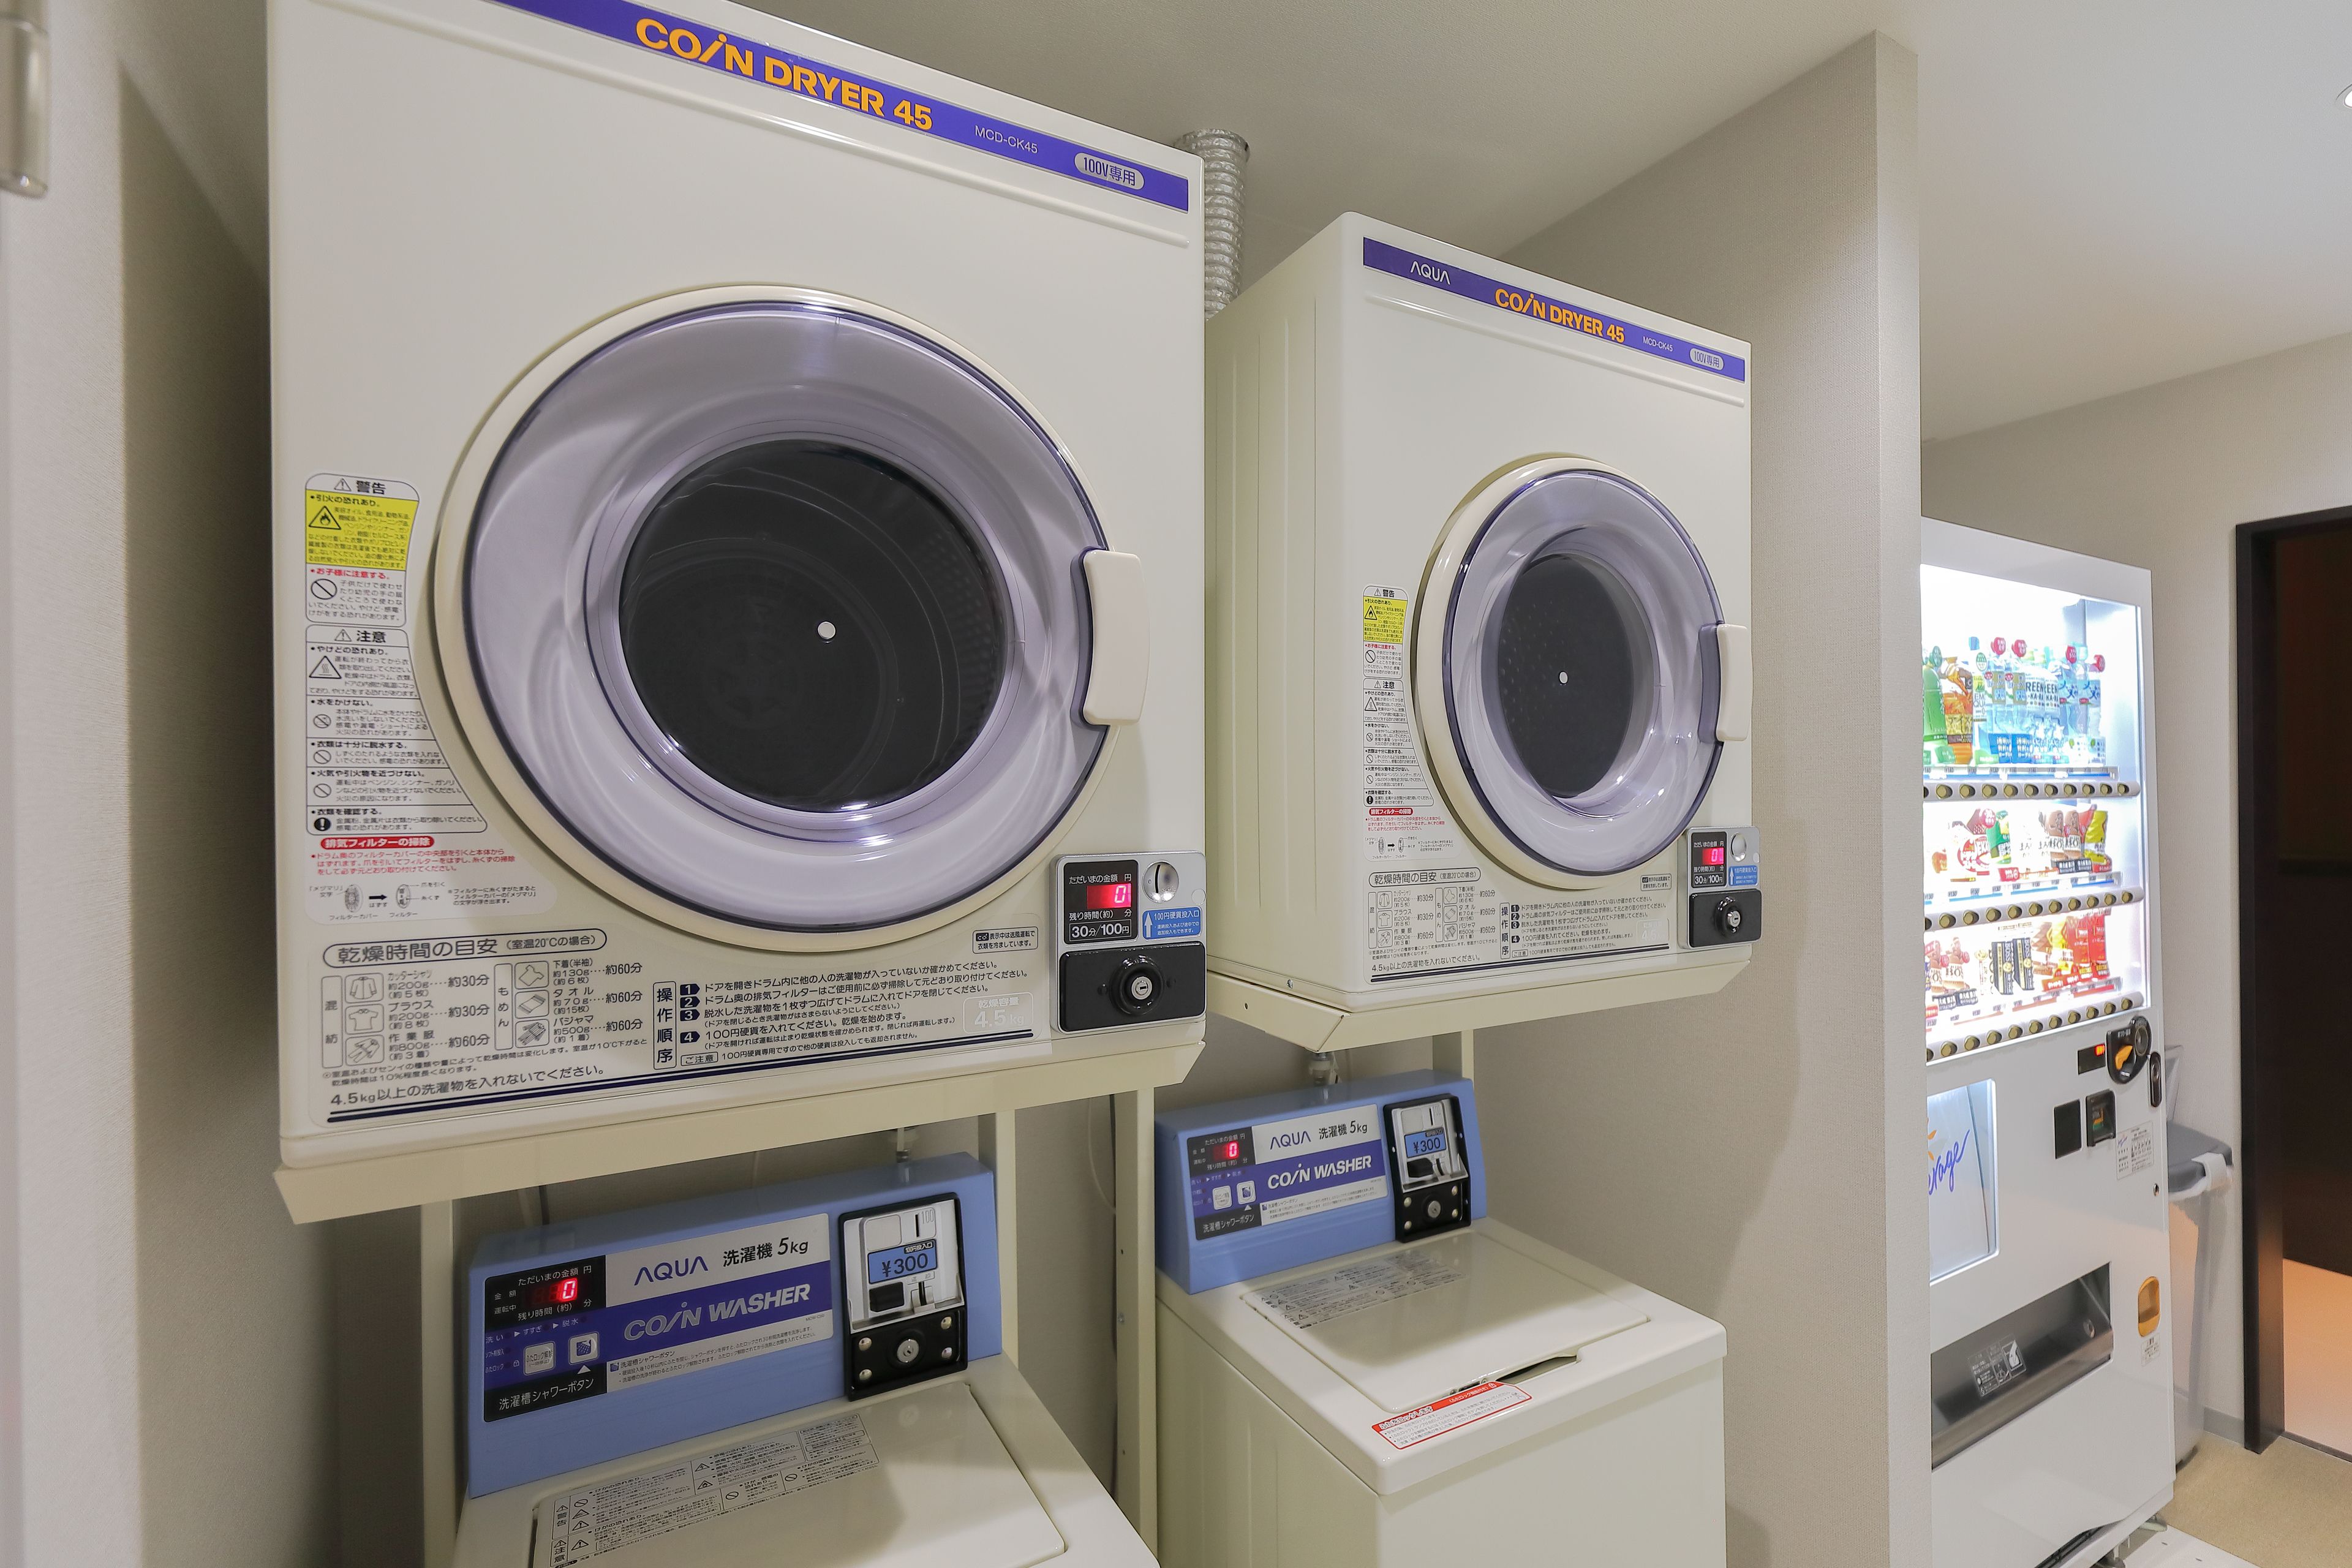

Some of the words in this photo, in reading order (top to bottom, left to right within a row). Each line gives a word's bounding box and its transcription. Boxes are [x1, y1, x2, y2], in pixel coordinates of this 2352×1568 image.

[764, 55, 884, 117] DRYER
[893, 99, 933, 130] 45
[974, 125, 1038, 154] MCD-CK45
[1083, 157, 1136, 186] 100V専用
[1411, 261, 1450, 285] AQUA
[1550, 305, 1603, 336] DRYER
[1607, 324, 1624, 343] 45
[1643, 336, 1673, 352] MCD-CK45
[1694, 351, 1719, 368] 100V専用
[356, 480, 386, 494] 警告
[1382, 589, 1395, 598] 警告
[356, 631, 386, 643] 注意
[325, 837, 431, 848] 排気フィルターの掃除
[1069, 874, 1118, 884] ただいまの金額
[1374, 872, 1437, 885] 乾燥時間の目安
[1114, 885, 1126, 903] 0
[1069, 910, 1114, 921] 残り時間(約)
[1125, 909, 1132, 918] 分
[1154, 910, 1199, 921] 100円硬貨投入口
[1072, 924, 1129, 938] 30分/100円
[338, 938, 497, 964] 乾燥時間の目安
[605, 962, 643, 975] 約60分
[448, 974, 489, 987] 約30分
[685, 985, 692, 994] 1
[705, 961, 997, 992] ドアを開きドラム内に他の人の洗濯物が入っていないか確かめてください。
[606, 990, 643, 1004] 約60分
[684, 997, 693, 1007] 2
[705, 970, 1027, 1005] ドラム奥の排気フィルターはご使用前に必ず掃除して元どおり取り付けてください。
[388, 1000, 434, 1012] ブラウス
[684, 1010, 693, 1020] 3
[704, 984, 988, 1019] 脱水した洗濯物を1枚ずつ広げてドラムに入れてドアを閉じてください。
[448, 1005, 490, 1018] 約30分
[553, 1015, 594, 1027] パジャマ
[606, 1019, 643, 1032] 約60分
[684, 1033, 693, 1042] 4
[706, 1011, 906, 1040] 100円硬貨を入れてください。乾燥を始めます。
[448, 1034, 490, 1049] 約60分
[685, 1055, 714, 1065] ご注意
[1270, 1131, 1311, 1150] AQUA
[1319, 1123, 1347, 1140] 洗濯機
[1350, 1120, 1368, 1134] 5kg
[1229, 1143, 1237, 1158] 0
[1414, 1137, 1441, 1154] ¥300
[1314, 1156, 1371, 1179] WASHER
[634, 1256, 708, 1286] AQUA
[723, 1243, 773, 1267] 洗濯機
[777, 1237, 809, 1256] 5kg
[882, 1253, 928, 1277] ¥300
[519, 1267, 578, 1286] ただいまの金額
[584, 1265, 592, 1274] 円
[562, 1280, 576, 1299] 0
[518, 1303, 572, 1321] 残り時間(約)
[584, 1298, 592, 1307] 分
[709, 1283, 810, 1322] WASHER
[620, 1350, 676, 1369] 洗濯槽シャワーボタン
[499, 1379, 594, 1411] 洗濯槽シャワーボタン
